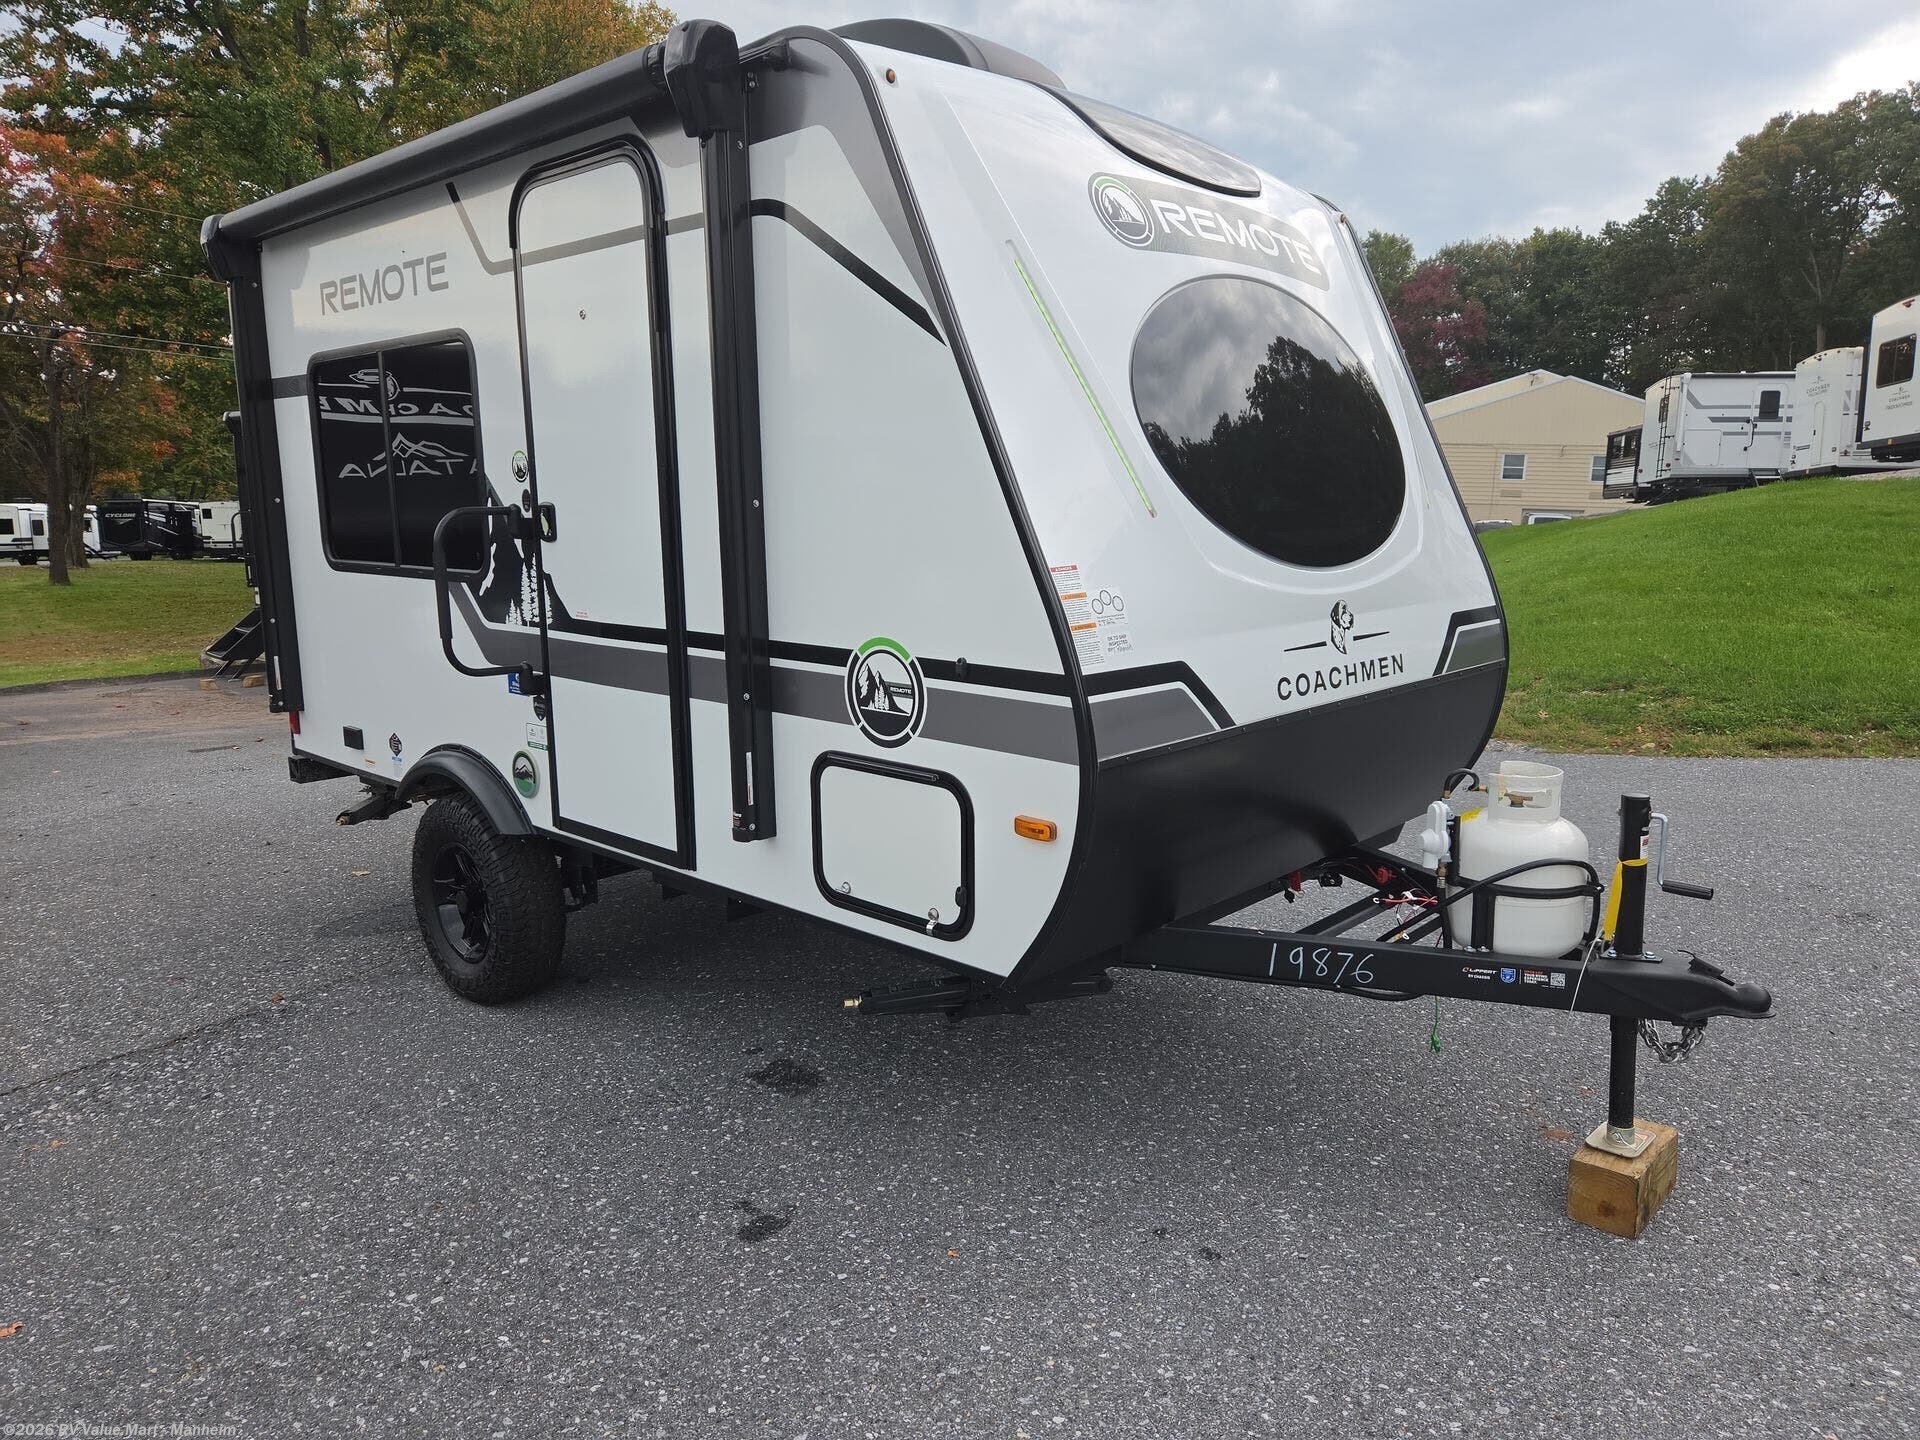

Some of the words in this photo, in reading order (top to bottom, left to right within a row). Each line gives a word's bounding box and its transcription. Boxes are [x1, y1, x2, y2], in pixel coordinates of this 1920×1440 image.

[1149, 199, 1323, 276] REMOTE
[320, 251, 449, 316] REMOTE
[890, 686, 912, 695] REMOTE
[1277, 653, 1404, 701] COACHMEN
[1268, 942, 1375, 984] 19876
